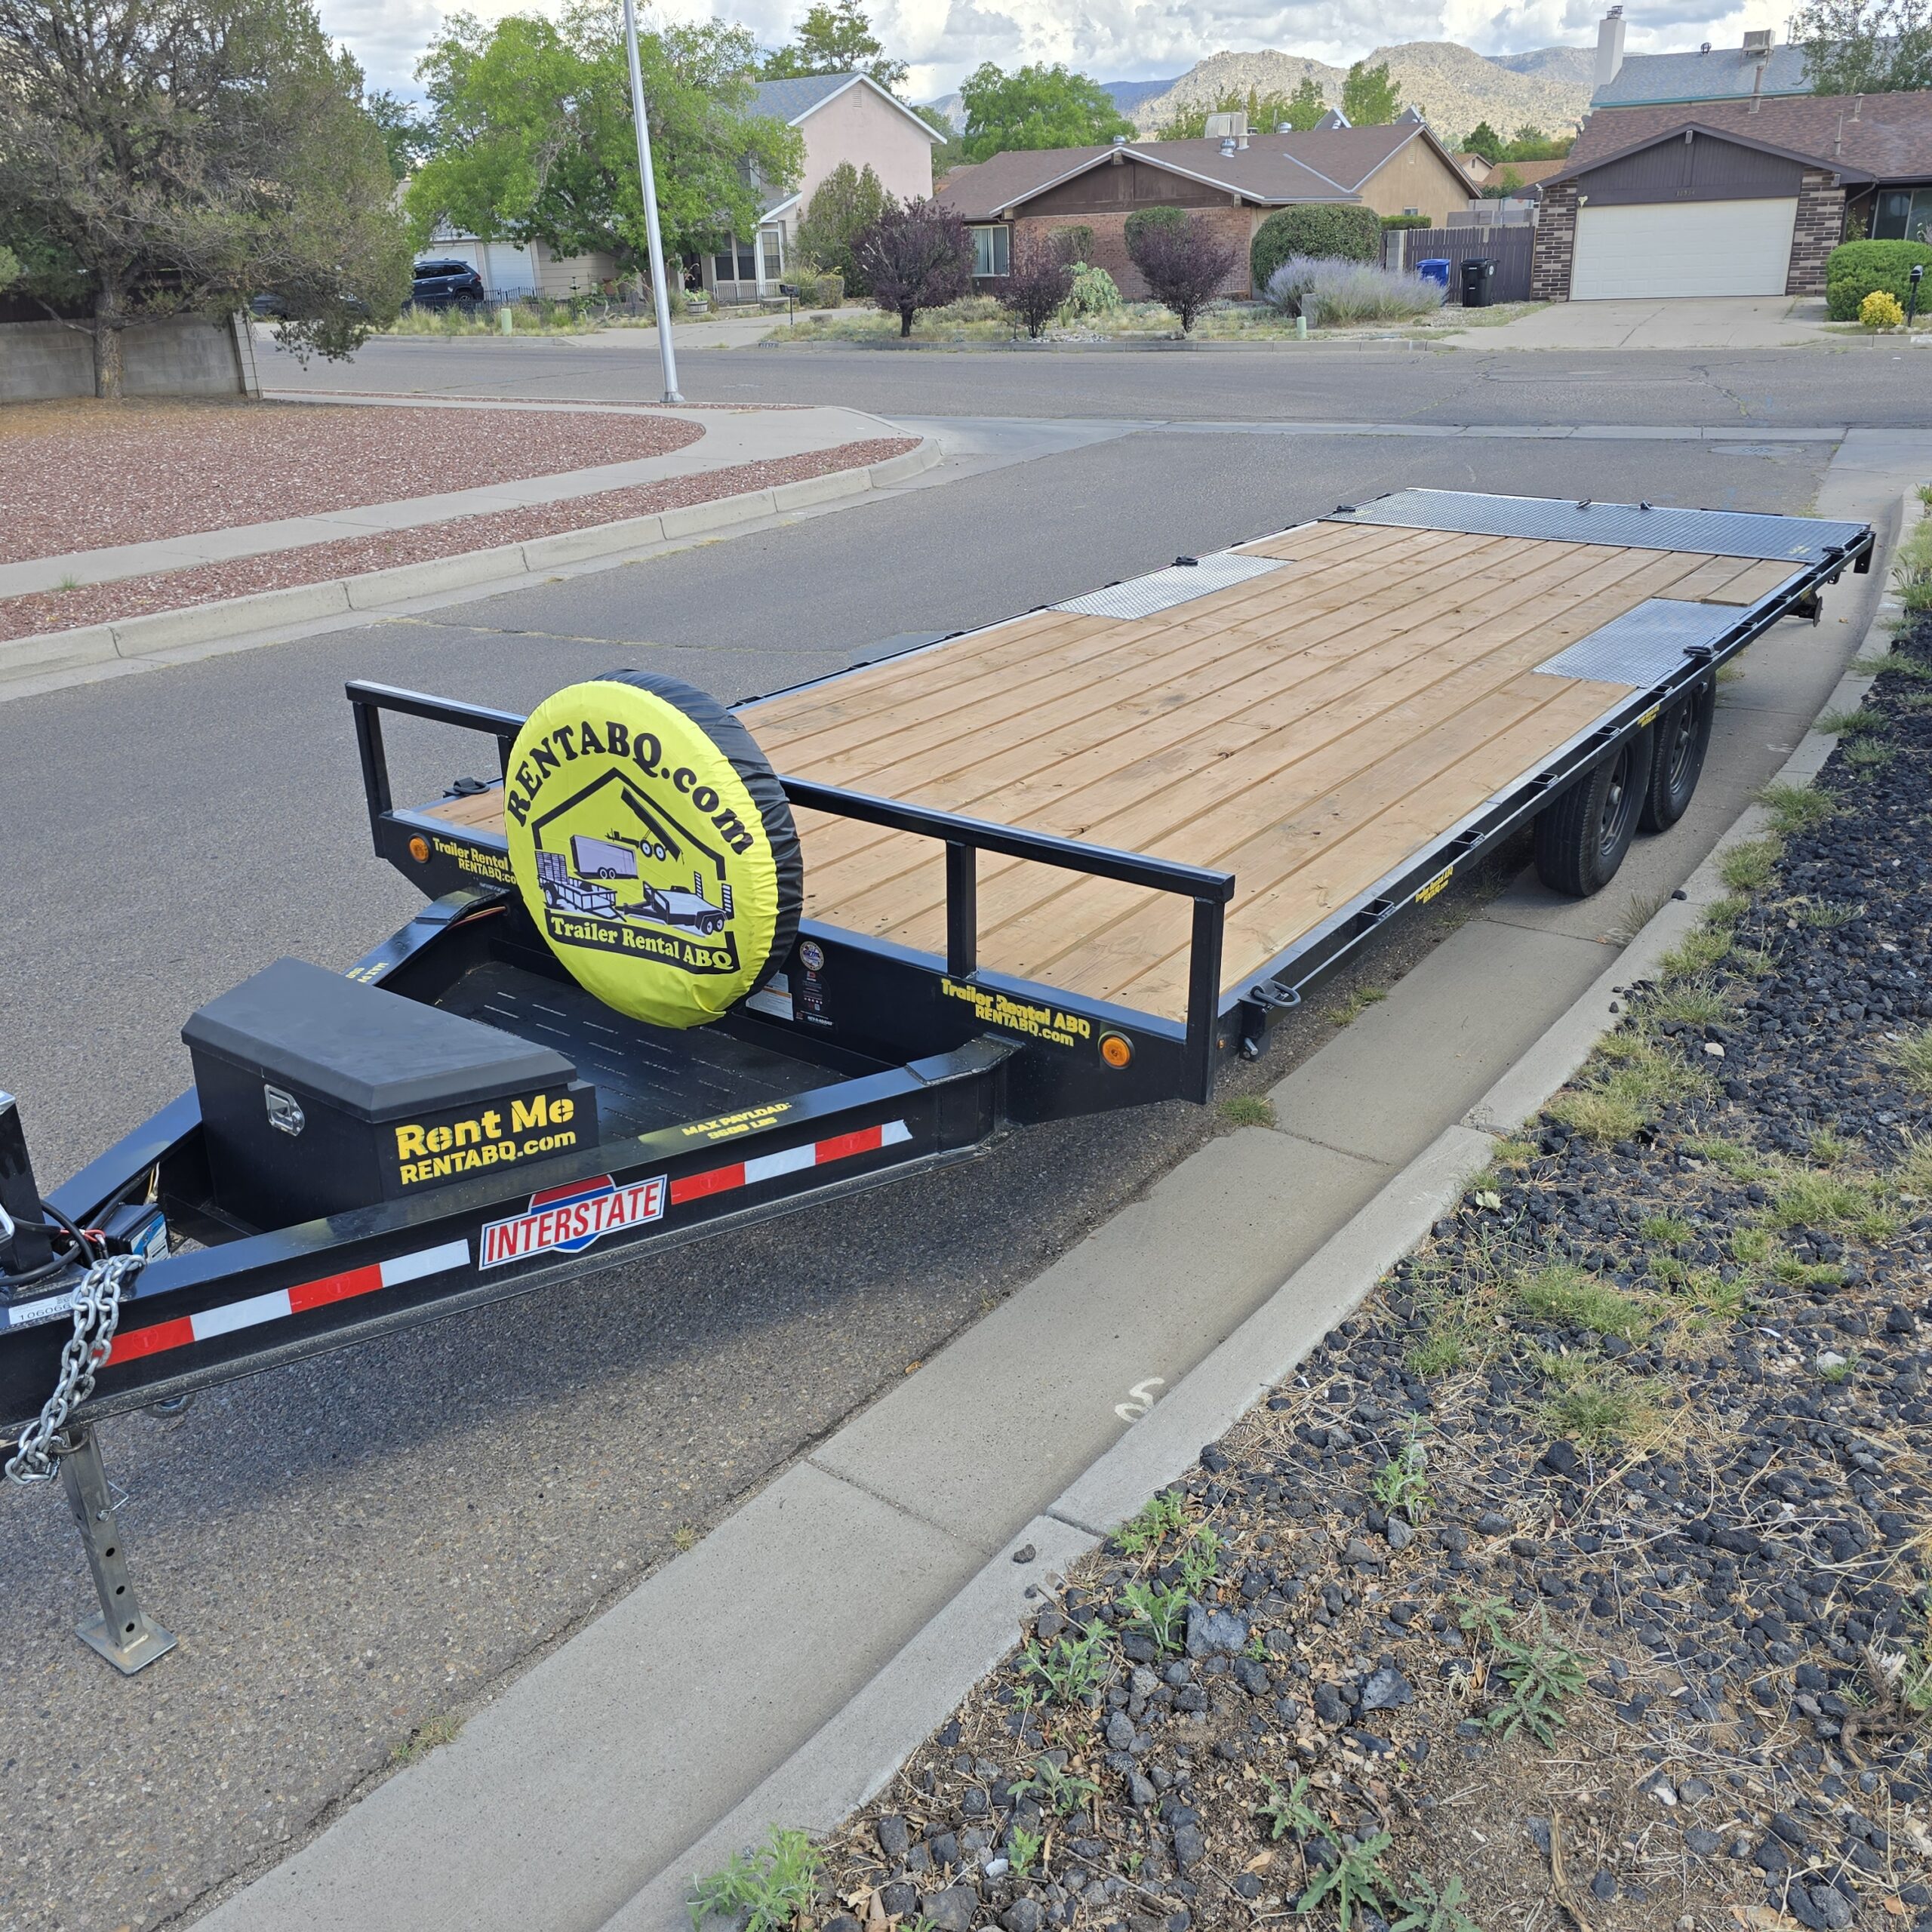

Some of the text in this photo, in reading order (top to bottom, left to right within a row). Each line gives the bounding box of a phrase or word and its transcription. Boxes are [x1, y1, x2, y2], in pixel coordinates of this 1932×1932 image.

[508, 721, 754, 855] RENTABQ.com
[432, 837, 509, 871] Trailer Rental
[551, 916, 734, 971] Trailer Rental ABQ
[941, 978, 1091, 1039] Trailer Rental ABQ
[975, 1004, 1075, 1048] RENTABQ.com
[395, 1094, 575, 1161] Rent Me
[681, 1119, 721, 1136] MAX
[399, 1131, 577, 1186] RENTABQ.com
[487, 1182, 660, 1263] INTERSTATE
